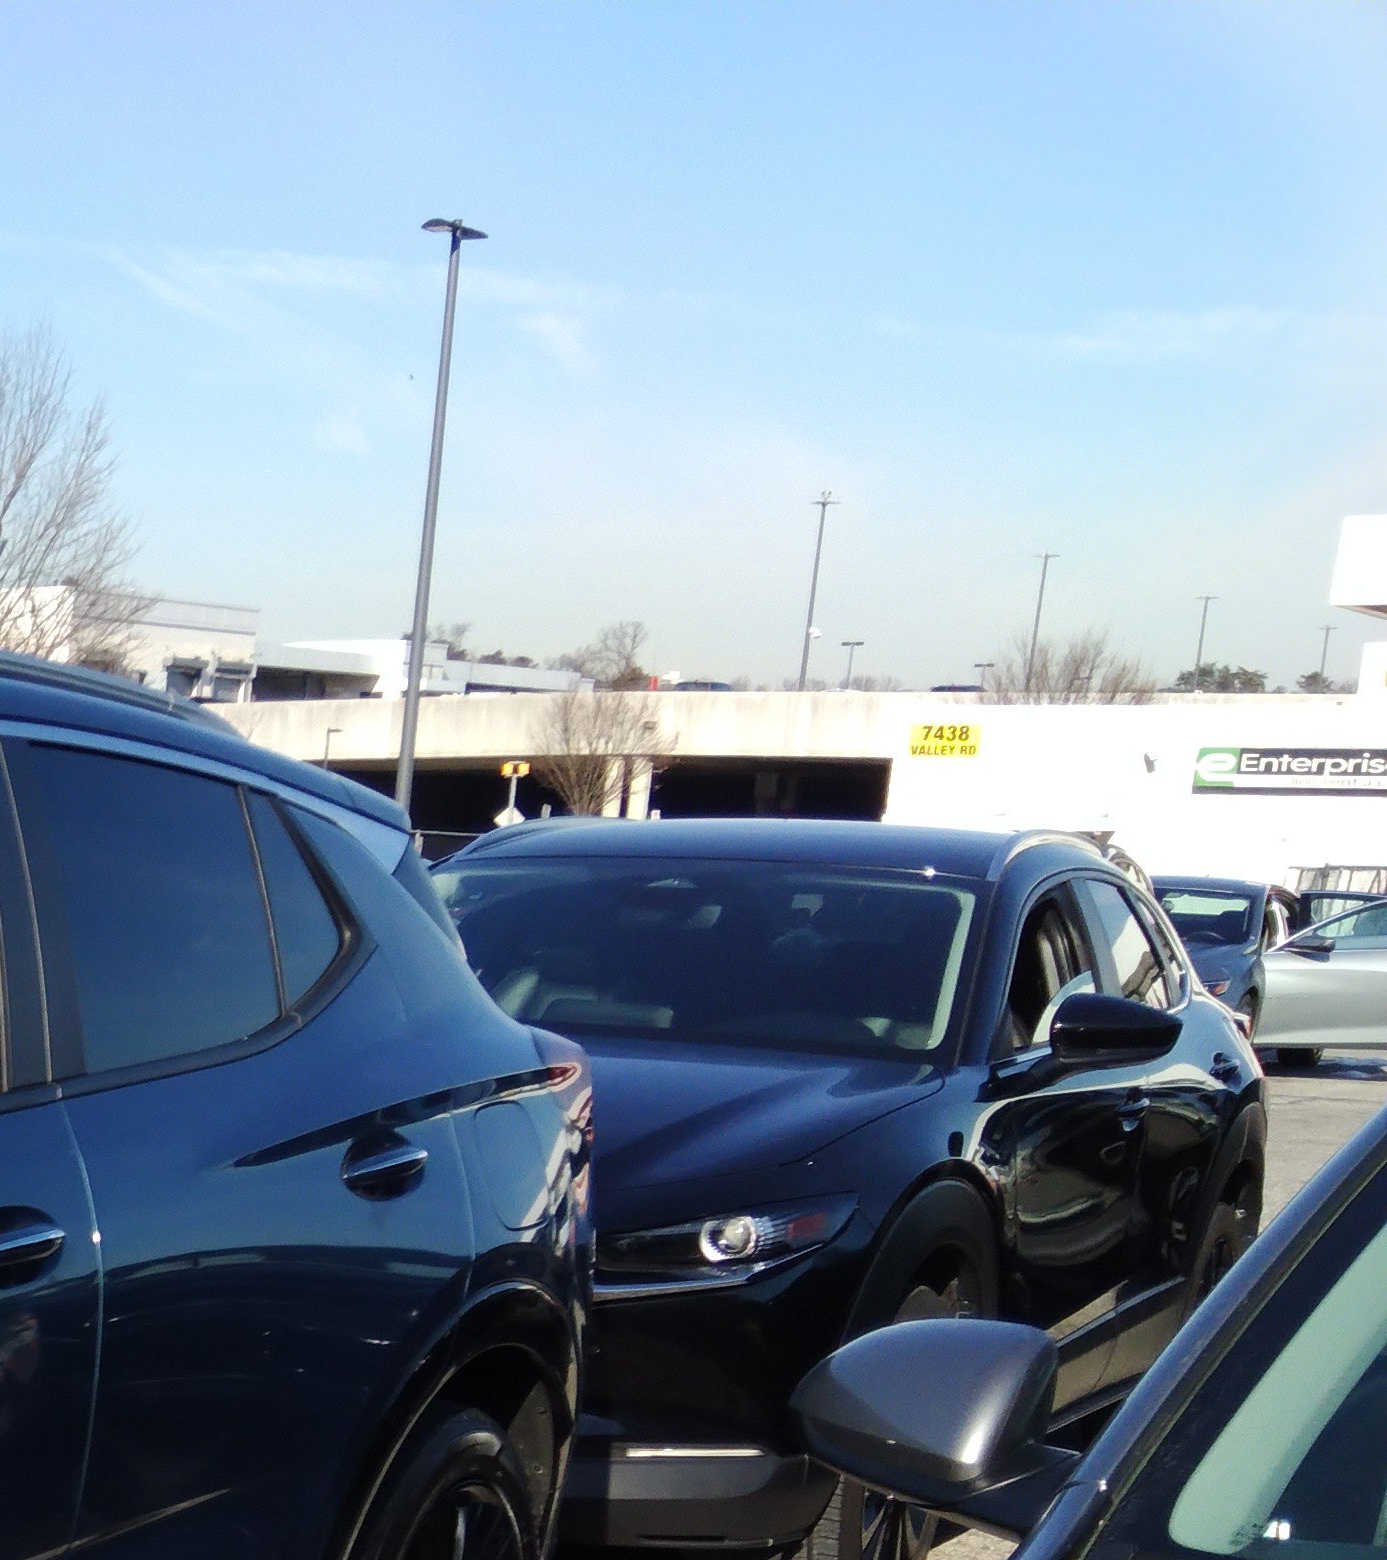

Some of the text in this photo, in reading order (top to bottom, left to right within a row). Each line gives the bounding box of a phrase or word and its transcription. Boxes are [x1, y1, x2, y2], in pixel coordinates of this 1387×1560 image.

[922, 725, 970, 741] 7438
[911, 745, 977, 756] VALLEY RD
[1239, 752, 1387, 777] Enterpris
